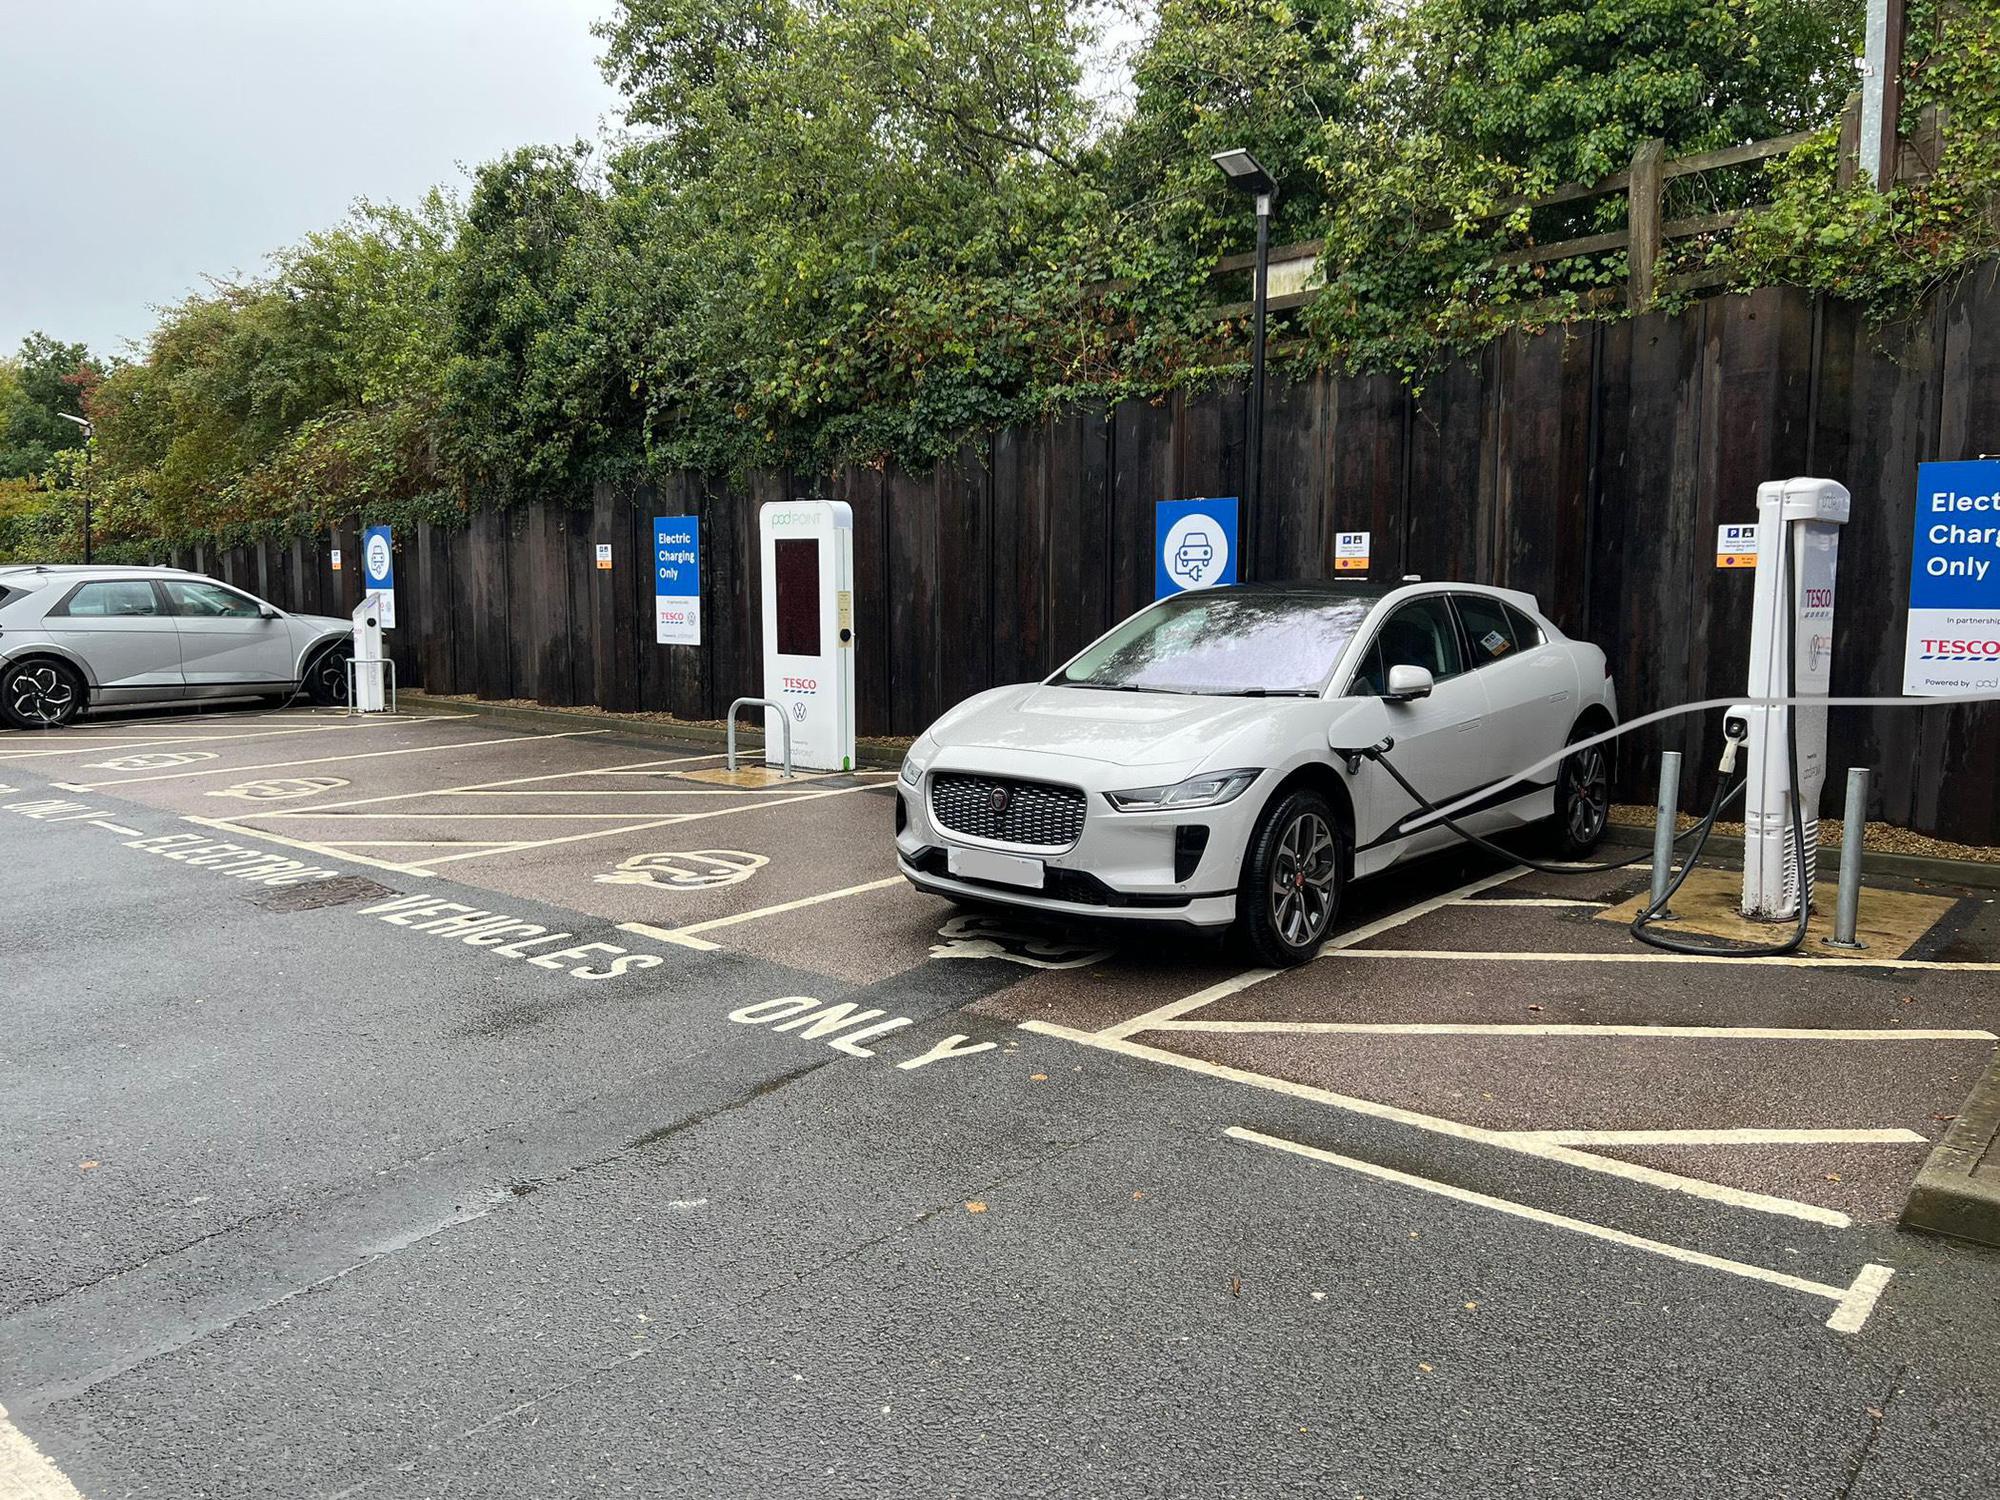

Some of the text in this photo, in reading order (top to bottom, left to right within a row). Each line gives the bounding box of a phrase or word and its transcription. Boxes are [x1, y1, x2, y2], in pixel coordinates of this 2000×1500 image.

[658, 532, 691, 544] Electric
[659, 550, 695, 564] Charging
[660, 567, 678, 581] Only
[1926, 556, 1990, 581] Only
[1806, 589, 1832, 608] TESCO
[661, 612, 684, 620] TESCO
[1920, 639, 2000, 655] TESCO
[783, 677, 817, 690] TESCO
[1925, 678, 1959, 687] Powered
[2, 799, 998, 1070] ONLY ELECTRIC VEHICLES ONLY
